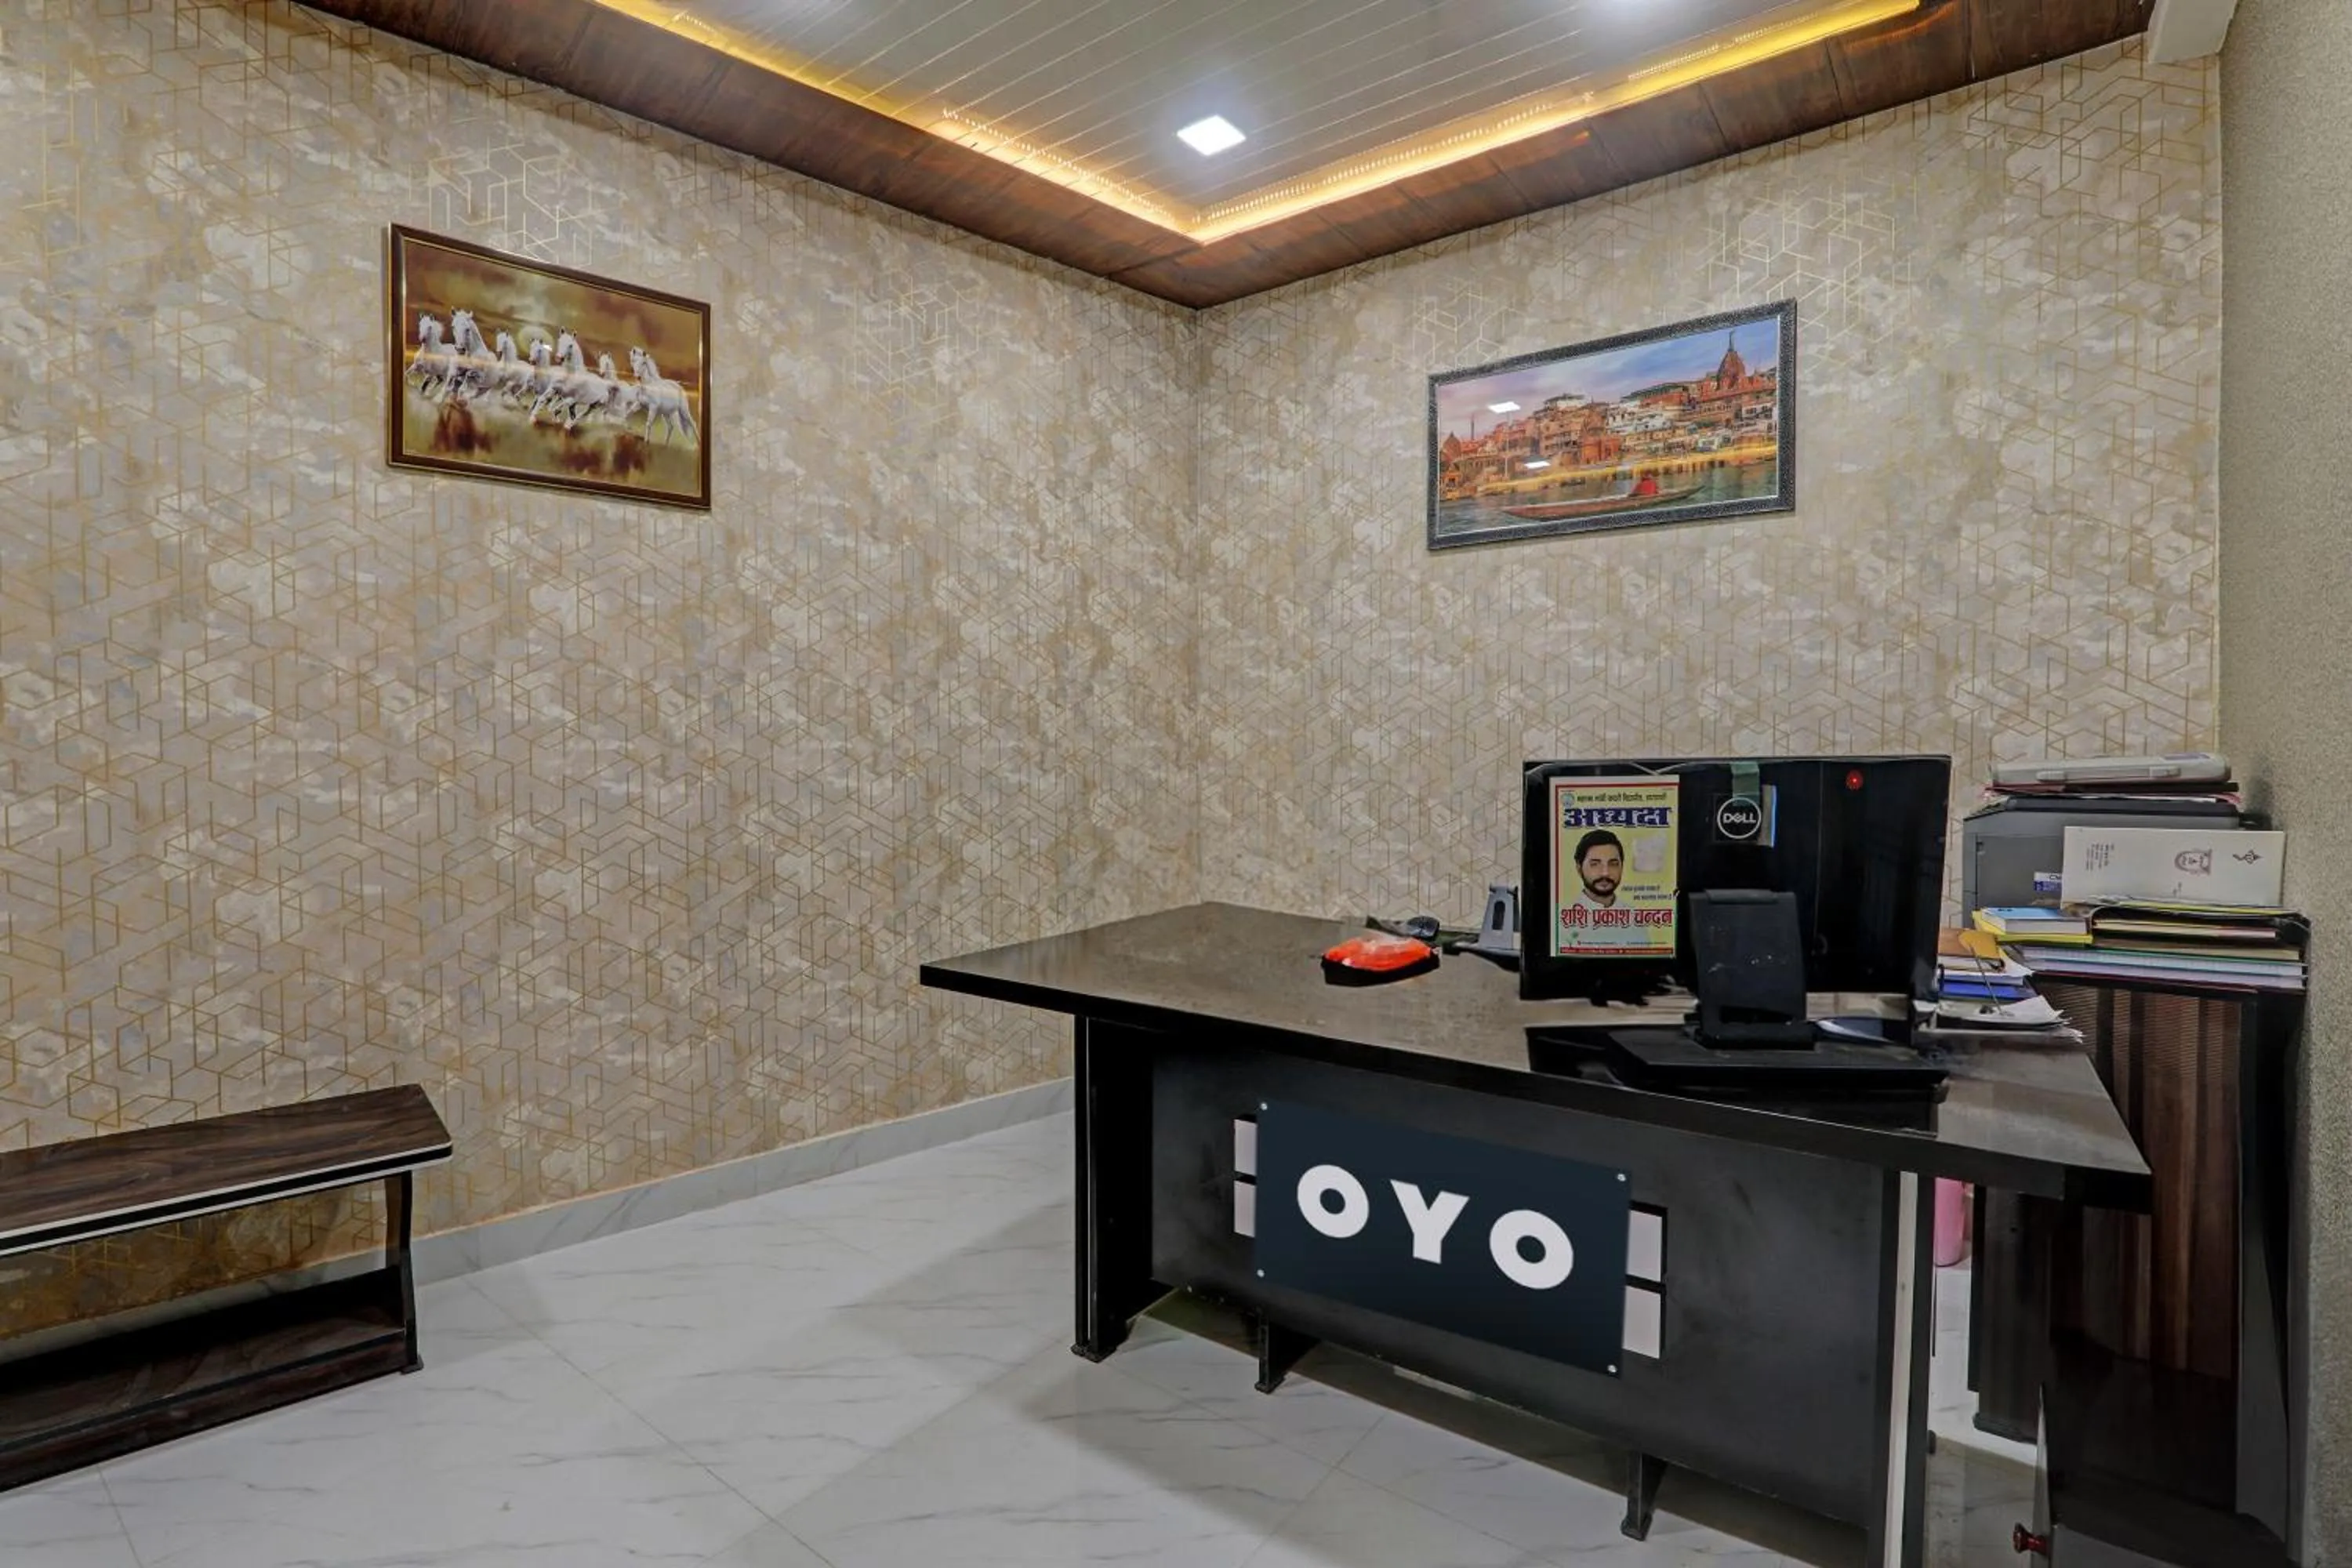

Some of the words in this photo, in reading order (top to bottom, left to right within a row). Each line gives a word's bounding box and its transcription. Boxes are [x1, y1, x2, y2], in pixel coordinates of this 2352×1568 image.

[1723, 812, 1757, 824] DELL
[1560, 903, 1588, 928] शशि
[1592, 908, 1631, 930] प्रकाश
[1298, 1164, 1573, 1290] OYO
